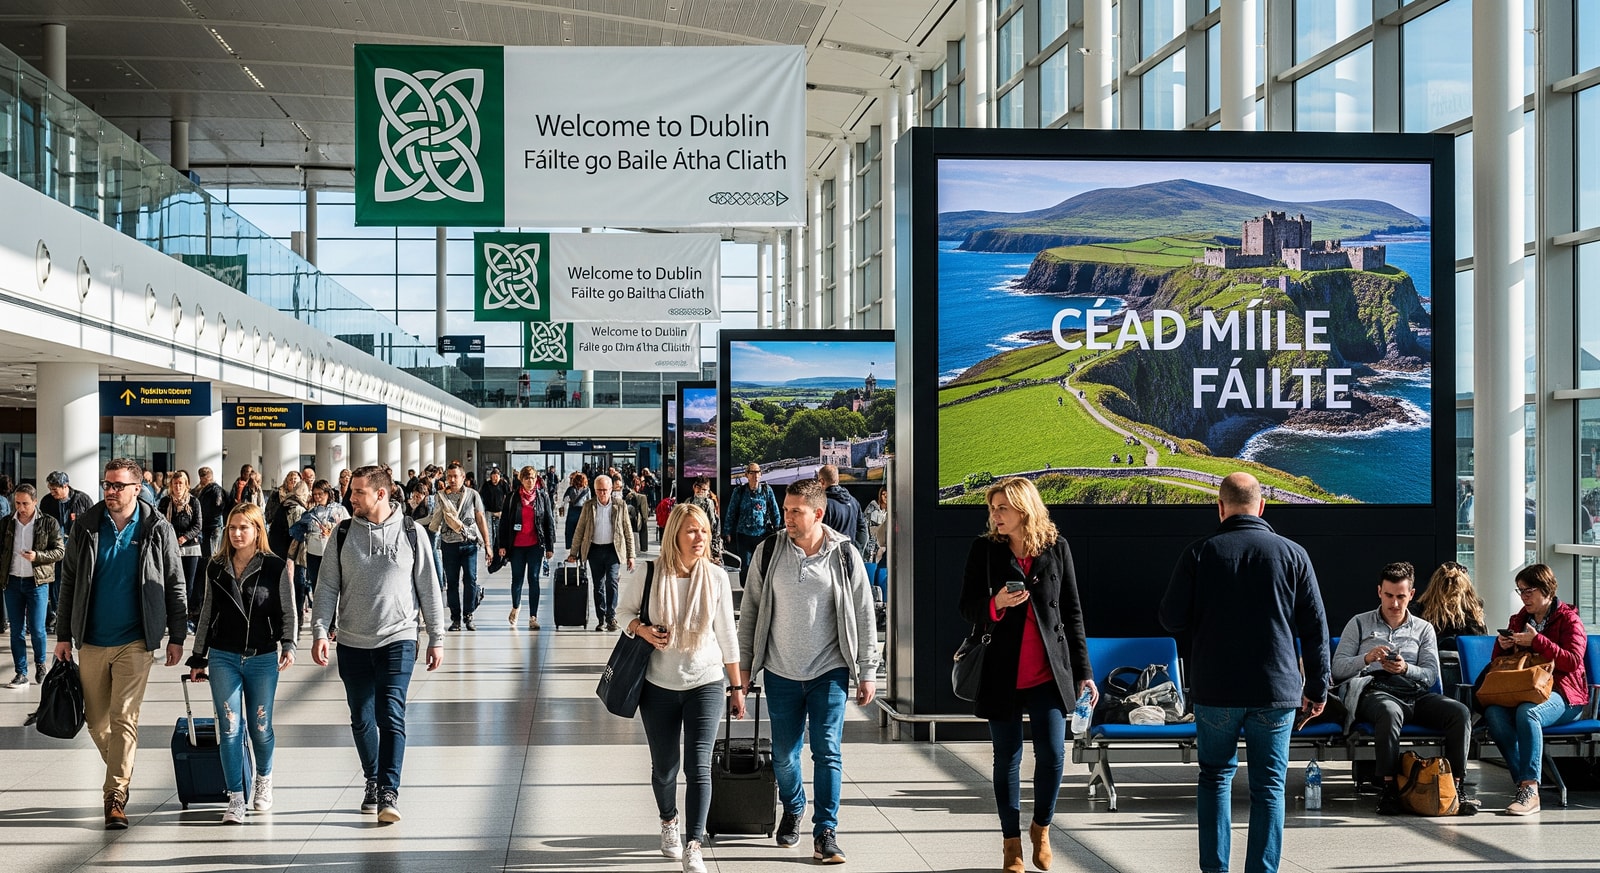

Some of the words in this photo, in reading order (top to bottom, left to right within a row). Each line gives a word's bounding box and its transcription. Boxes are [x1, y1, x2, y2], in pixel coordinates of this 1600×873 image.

[535, 113, 650, 137] Welcome
[656, 116, 682, 137] to
[690, 114, 769, 137] Dublin
[524, 149, 580, 170] Fáilte
[585, 155, 612, 174] go
[618, 149, 668, 170] Baile
[673, 147, 721, 170] Átha
[726, 149, 787, 170] Cliath
[567, 266, 633, 280] Welcome
[636, 267, 652, 280] to
[656, 266, 702, 280] Dublin
[608, 289, 625, 303] go
[591, 325, 639, 337] Welcome
[641, 326, 653, 337] to
[655, 326, 688, 337] Dublin
[1051, 298, 1187, 351] CÉAD
[601, 344, 614, 354] go
[1193, 357, 1353, 409] FÁILTE
